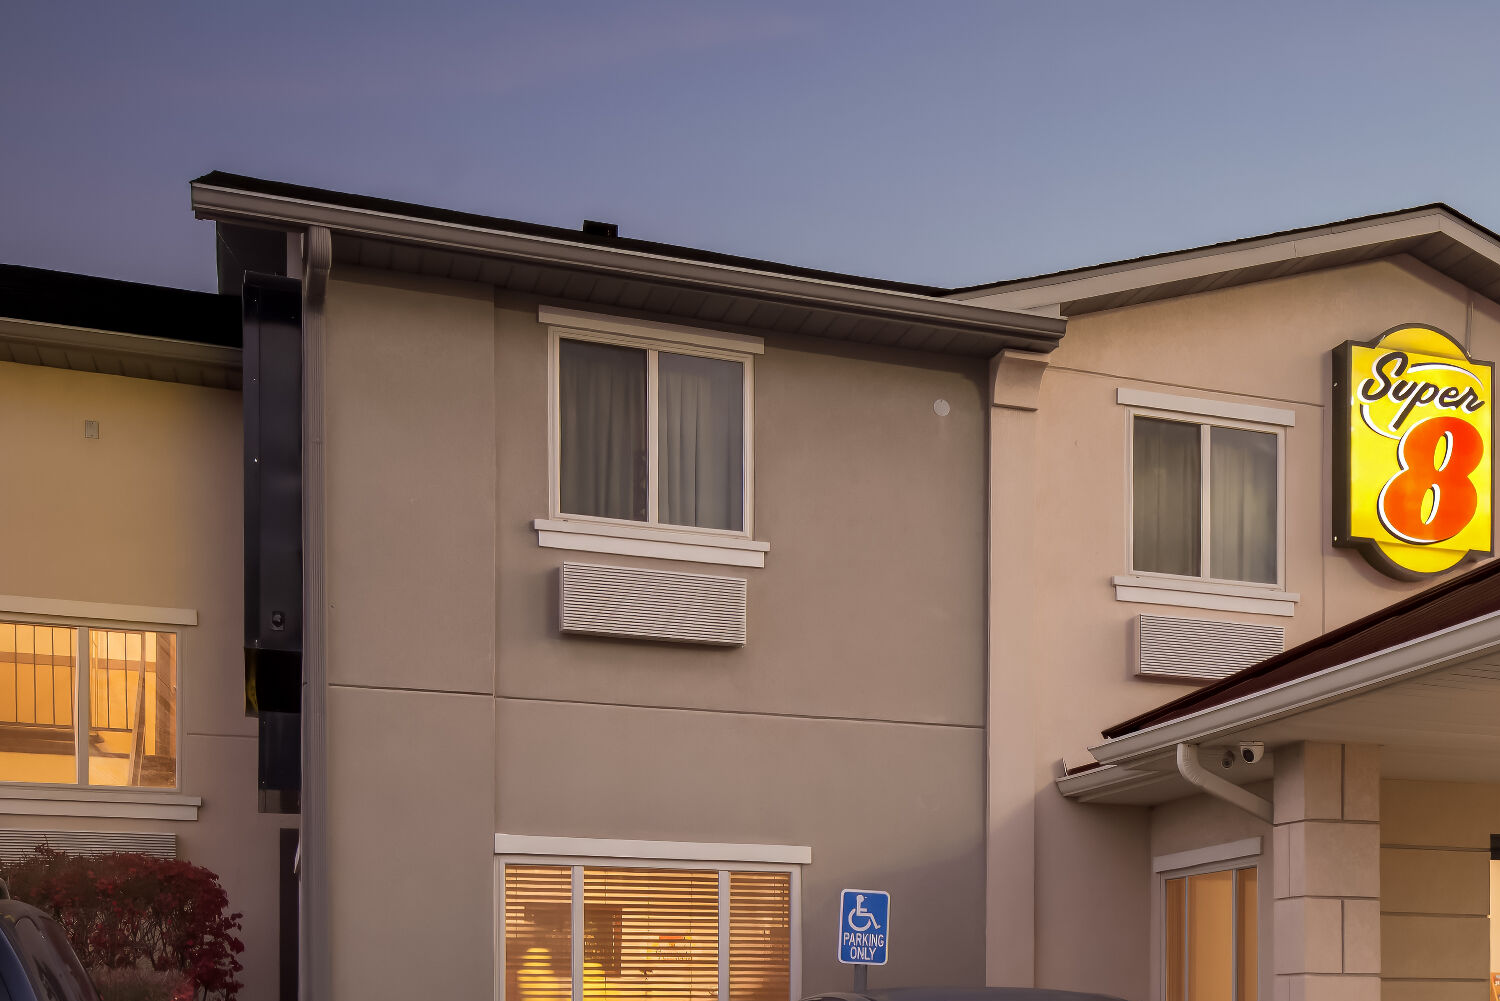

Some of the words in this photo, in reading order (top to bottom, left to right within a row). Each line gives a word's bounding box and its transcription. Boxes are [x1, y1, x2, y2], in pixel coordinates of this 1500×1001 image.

[1358, 351, 1485, 431] Super
[1377, 416, 1484, 545] 8
[843, 932, 884, 947] PARKING
[850, 946, 877, 961] ONLY
